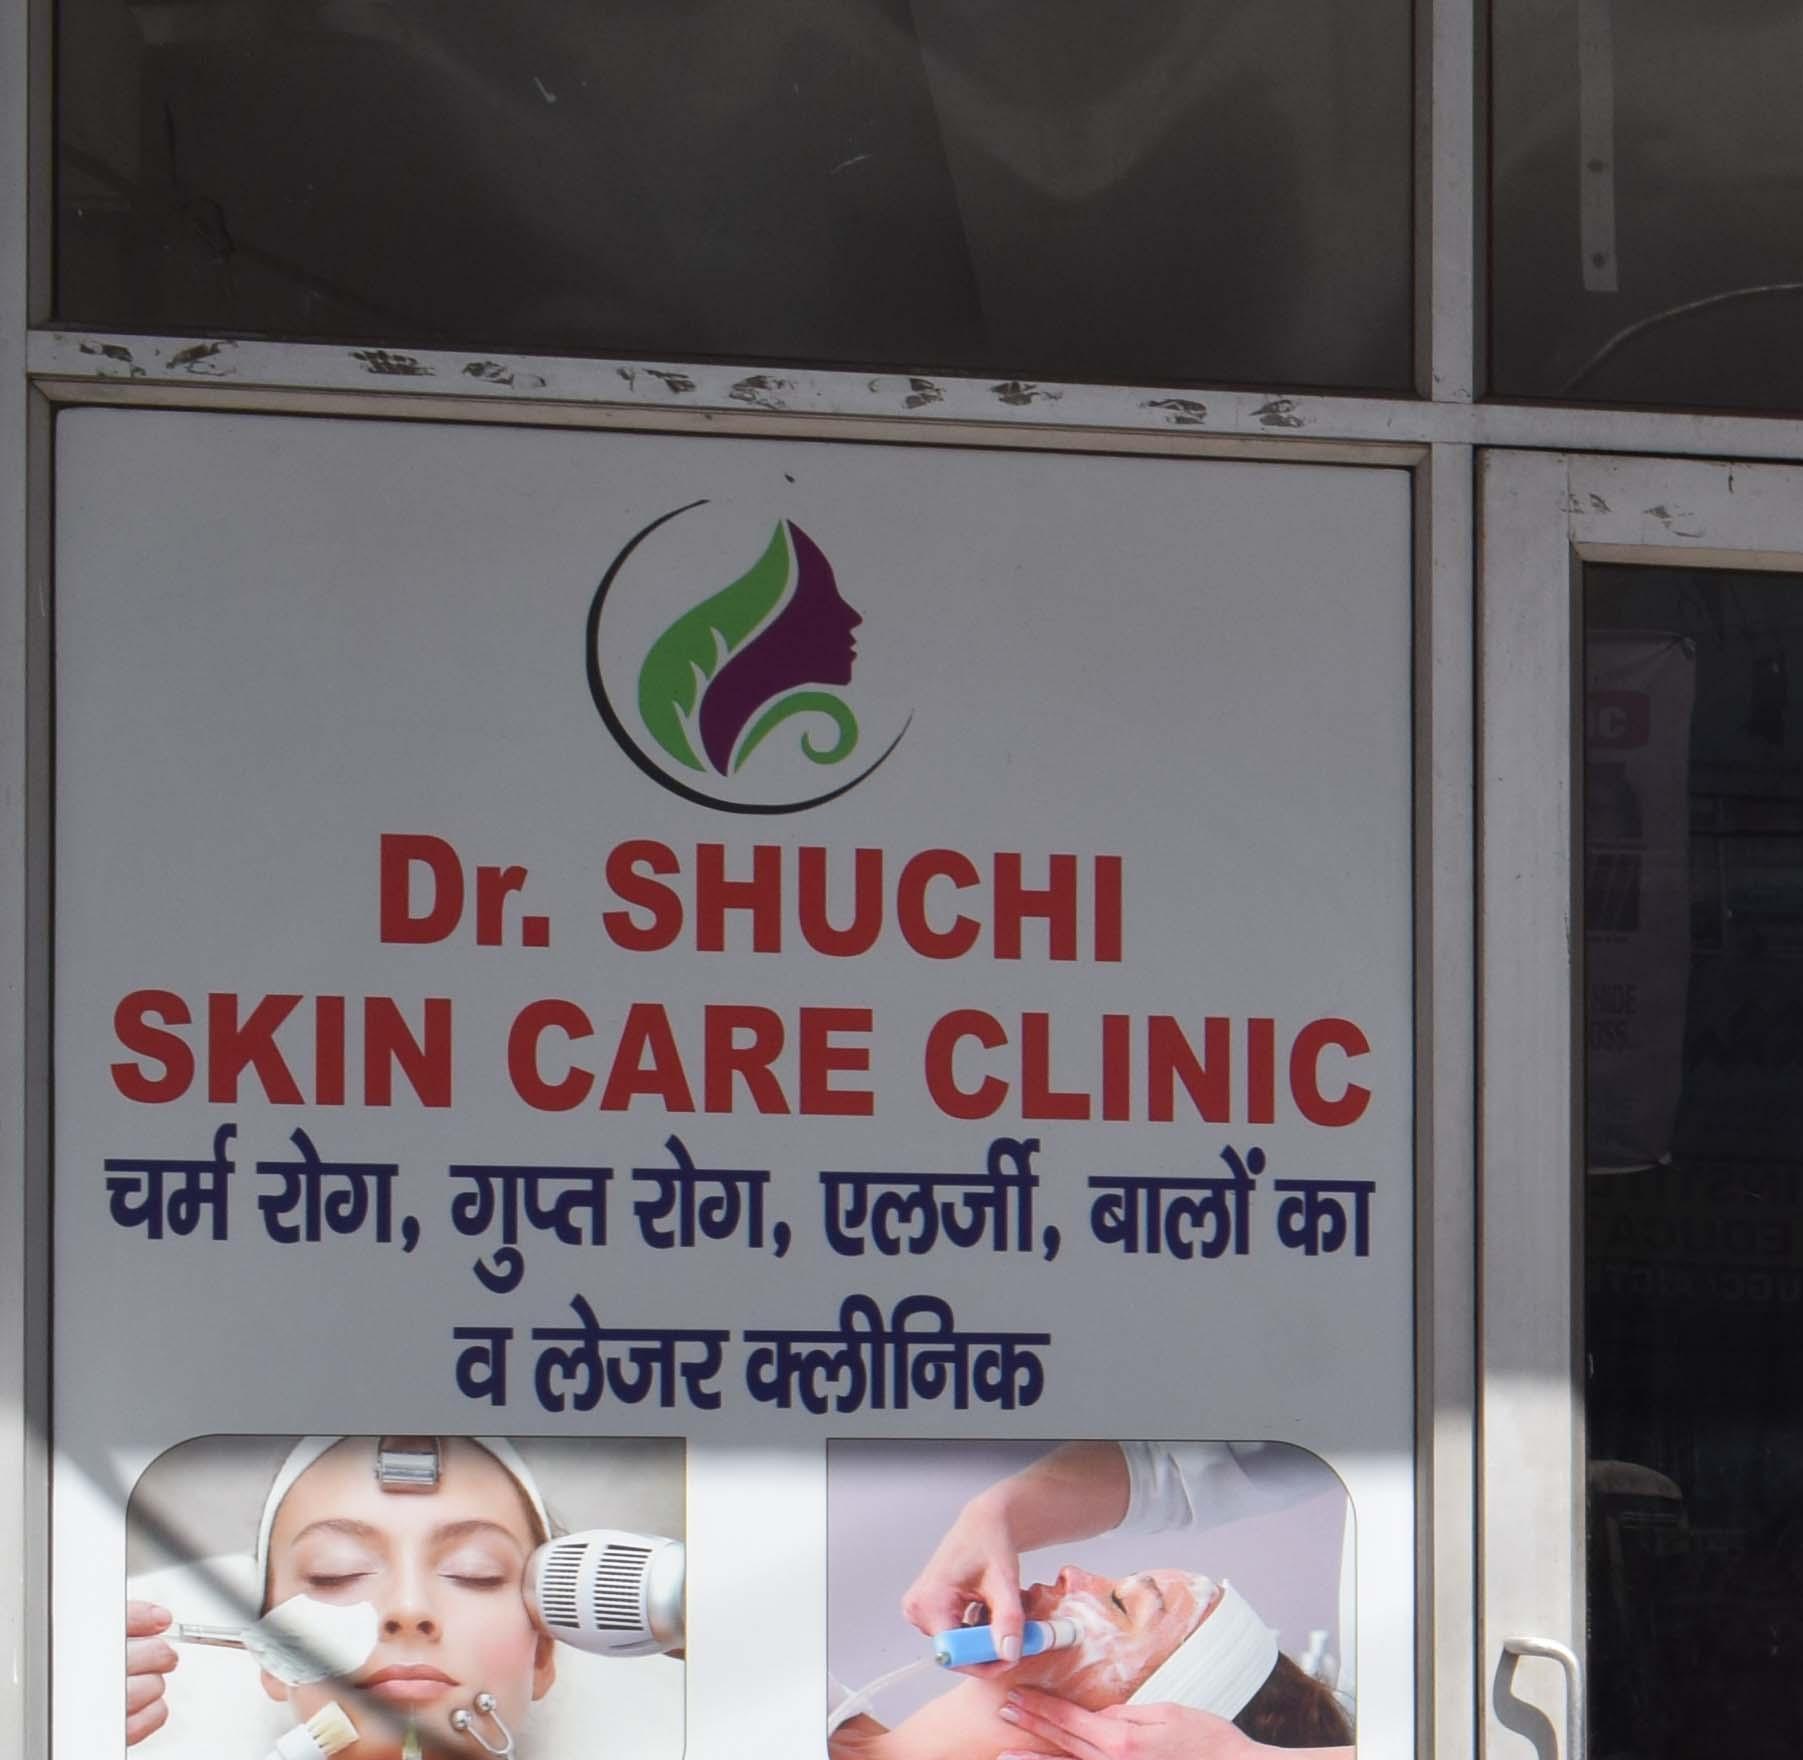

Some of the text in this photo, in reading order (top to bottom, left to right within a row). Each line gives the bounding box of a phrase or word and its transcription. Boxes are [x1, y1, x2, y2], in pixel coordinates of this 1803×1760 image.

[381, 834, 1122, 961] Dr. SHUCHI
[112, 990, 1370, 1126] SKIN CARE CLINIC
[104, 1123, 1375, 1293] चर्म रोग, गुप्त रोग, एलर्जी, बालों का
[454, 1294, 1050, 1414] व लेजर क्लीनिक
